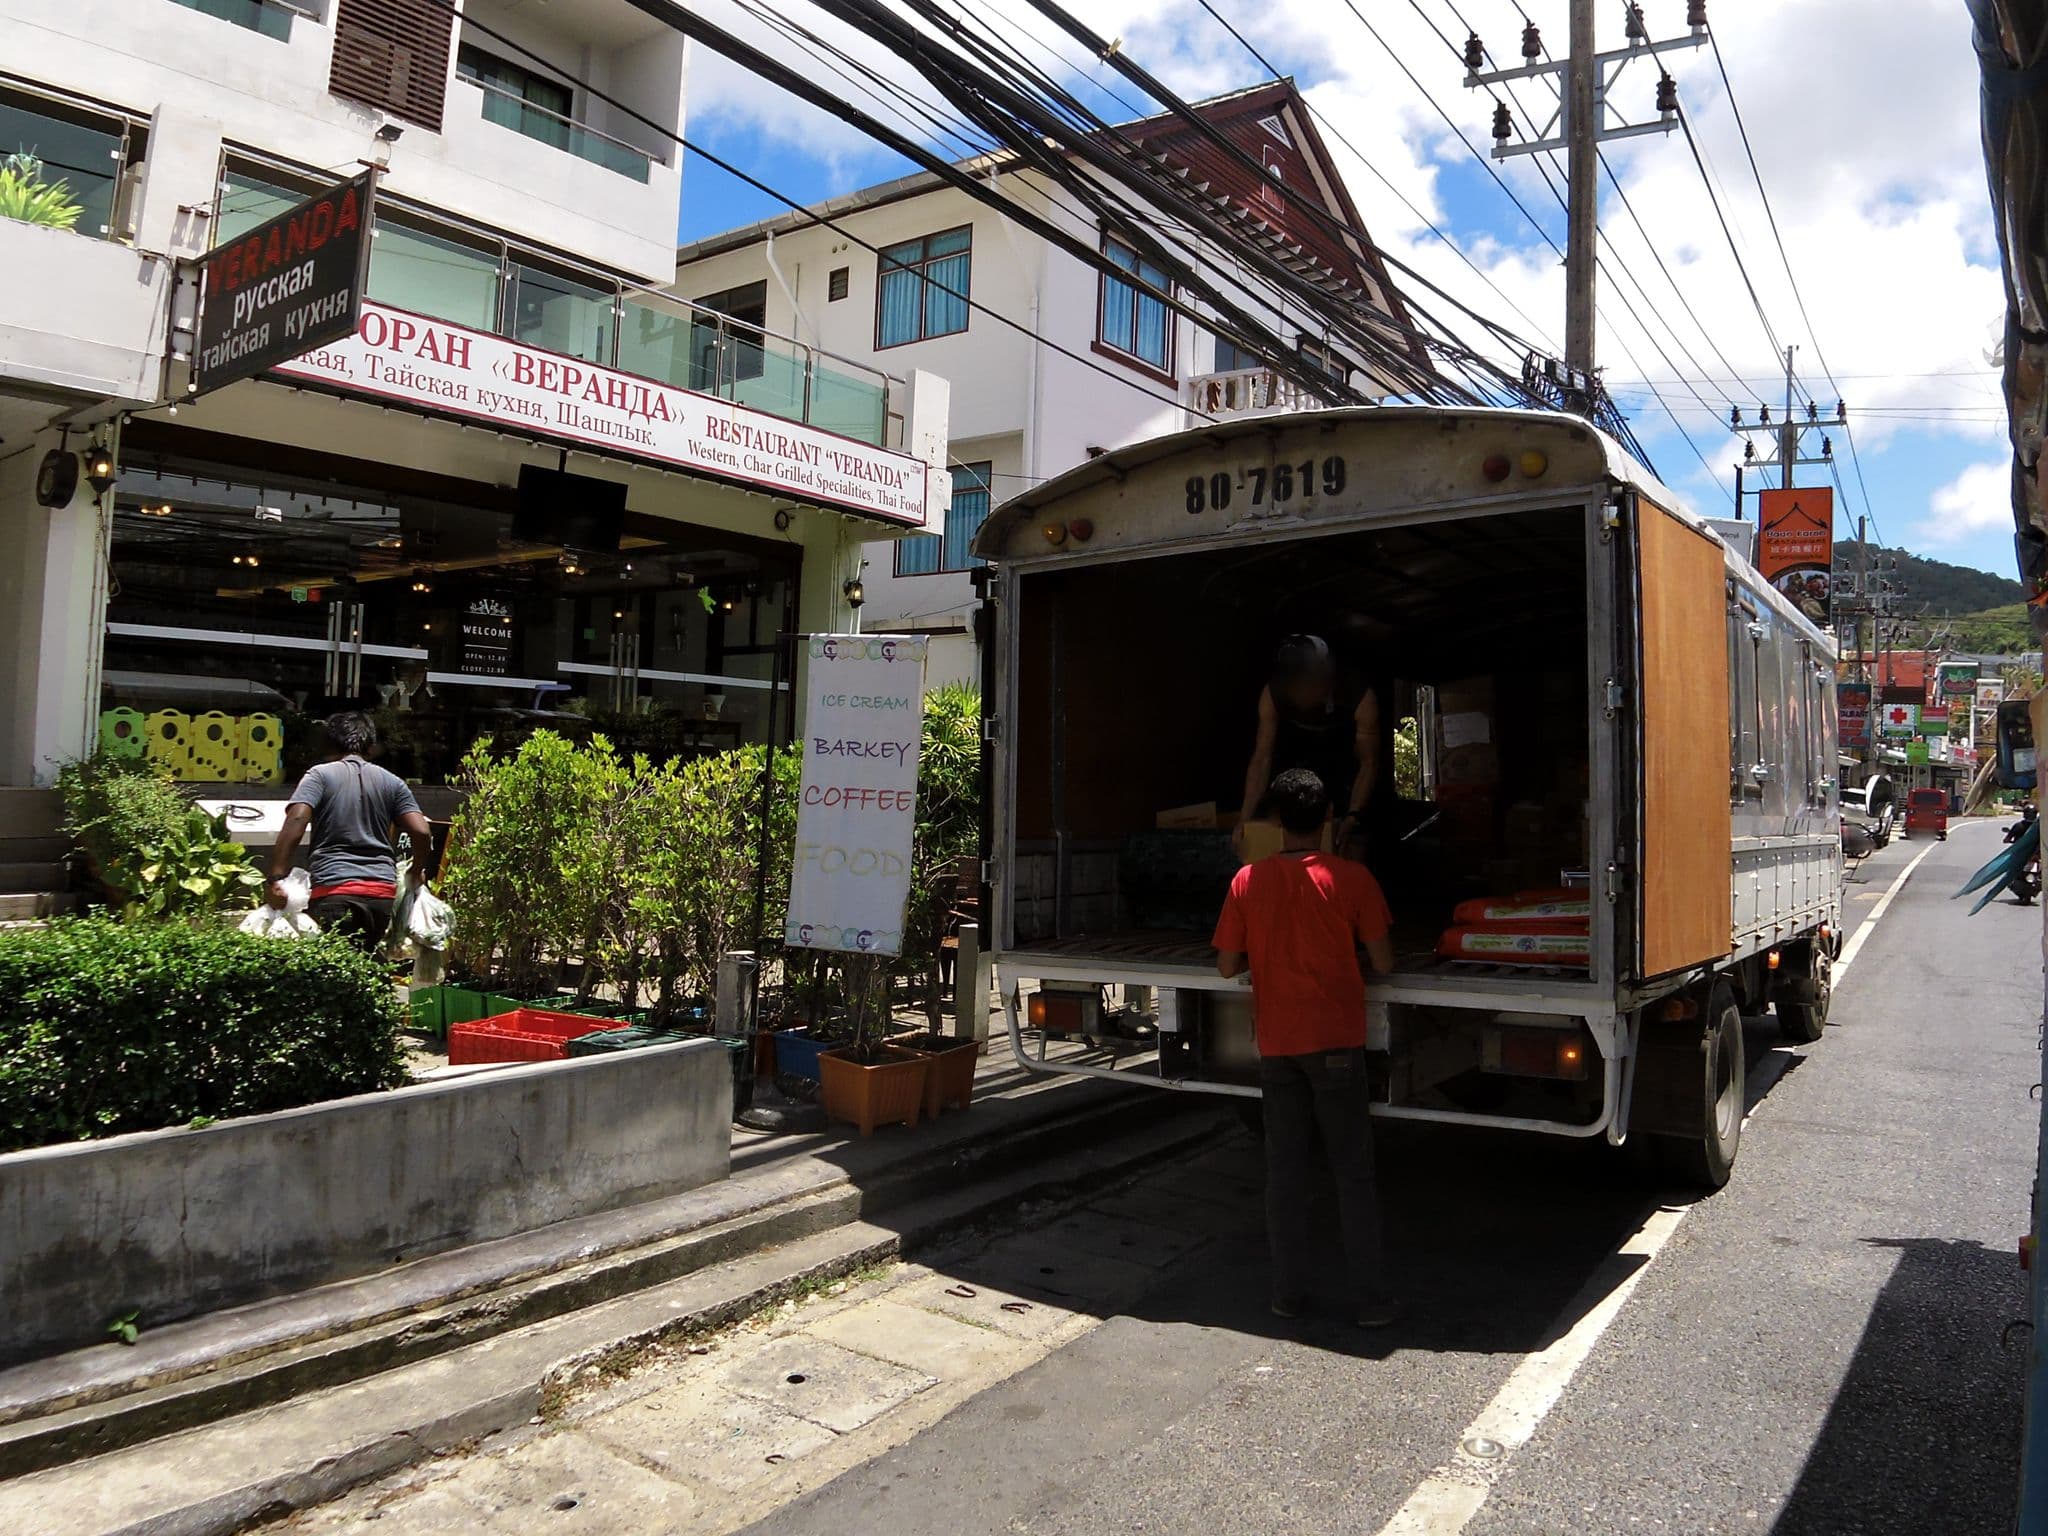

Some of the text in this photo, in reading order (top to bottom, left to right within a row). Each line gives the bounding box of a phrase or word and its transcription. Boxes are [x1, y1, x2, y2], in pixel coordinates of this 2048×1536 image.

[208, 188, 358, 297] VERANDA
[233, 260, 315, 329] русская
[202, 288, 349, 372] тайская кухня
[359, 312, 473, 371] ОРАН
[364, 353, 468, 401] Тайская
[476, 388, 549, 425] кухня,
[555, 401, 658, 447] Шашлык.
[687, 439, 923, 514] Western, Char Grilled Specialities, Thai Food
[705, 414, 910, 490] RESTAURANT “VERANDA”
[1185, 455, 1347, 515] 80-7619
[463, 625, 512, 639] WELCOME
[822, 694, 909, 711] ICE CREAM
[1840, 709, 1868, 718] TAURANT
[813, 737, 912, 768] BARKEY
[804, 784, 913, 812] COFFEE
[800, 841, 905, 879] FOOD
